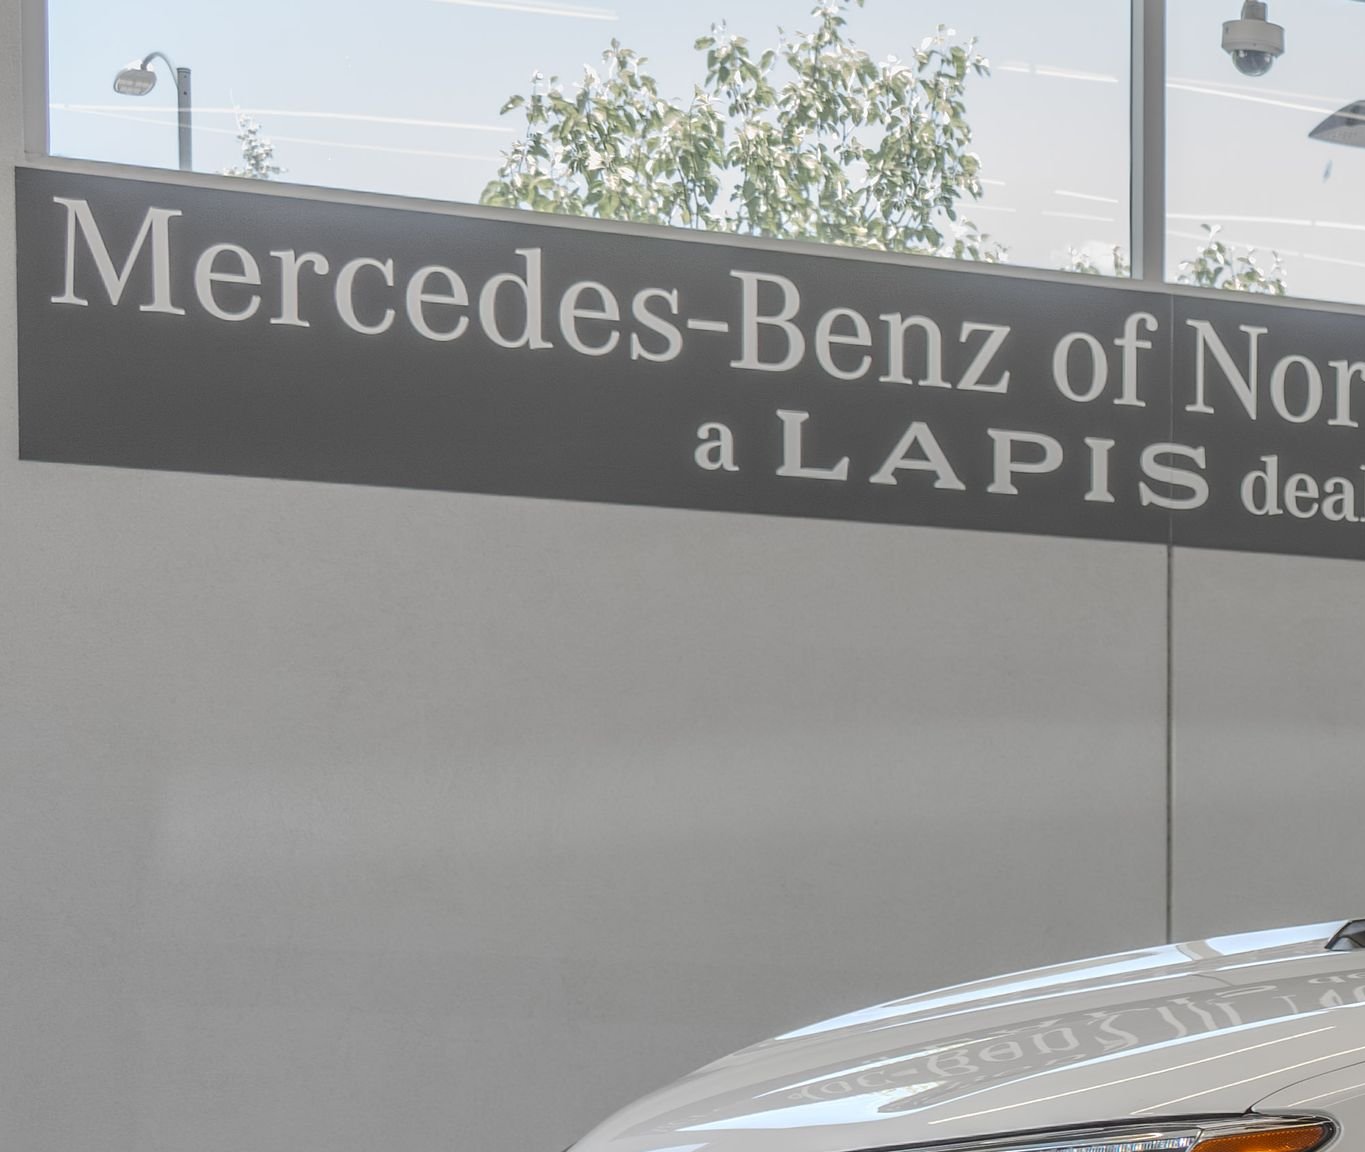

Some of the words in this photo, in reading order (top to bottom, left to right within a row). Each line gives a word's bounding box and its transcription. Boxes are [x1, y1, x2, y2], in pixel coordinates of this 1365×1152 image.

[50, 195, 1011, 394] Mercedes-Benz
[1052, 311, 1159, 408] of
[694, 422, 740, 472] a
[776, 408, 1209, 510] LAPIS
